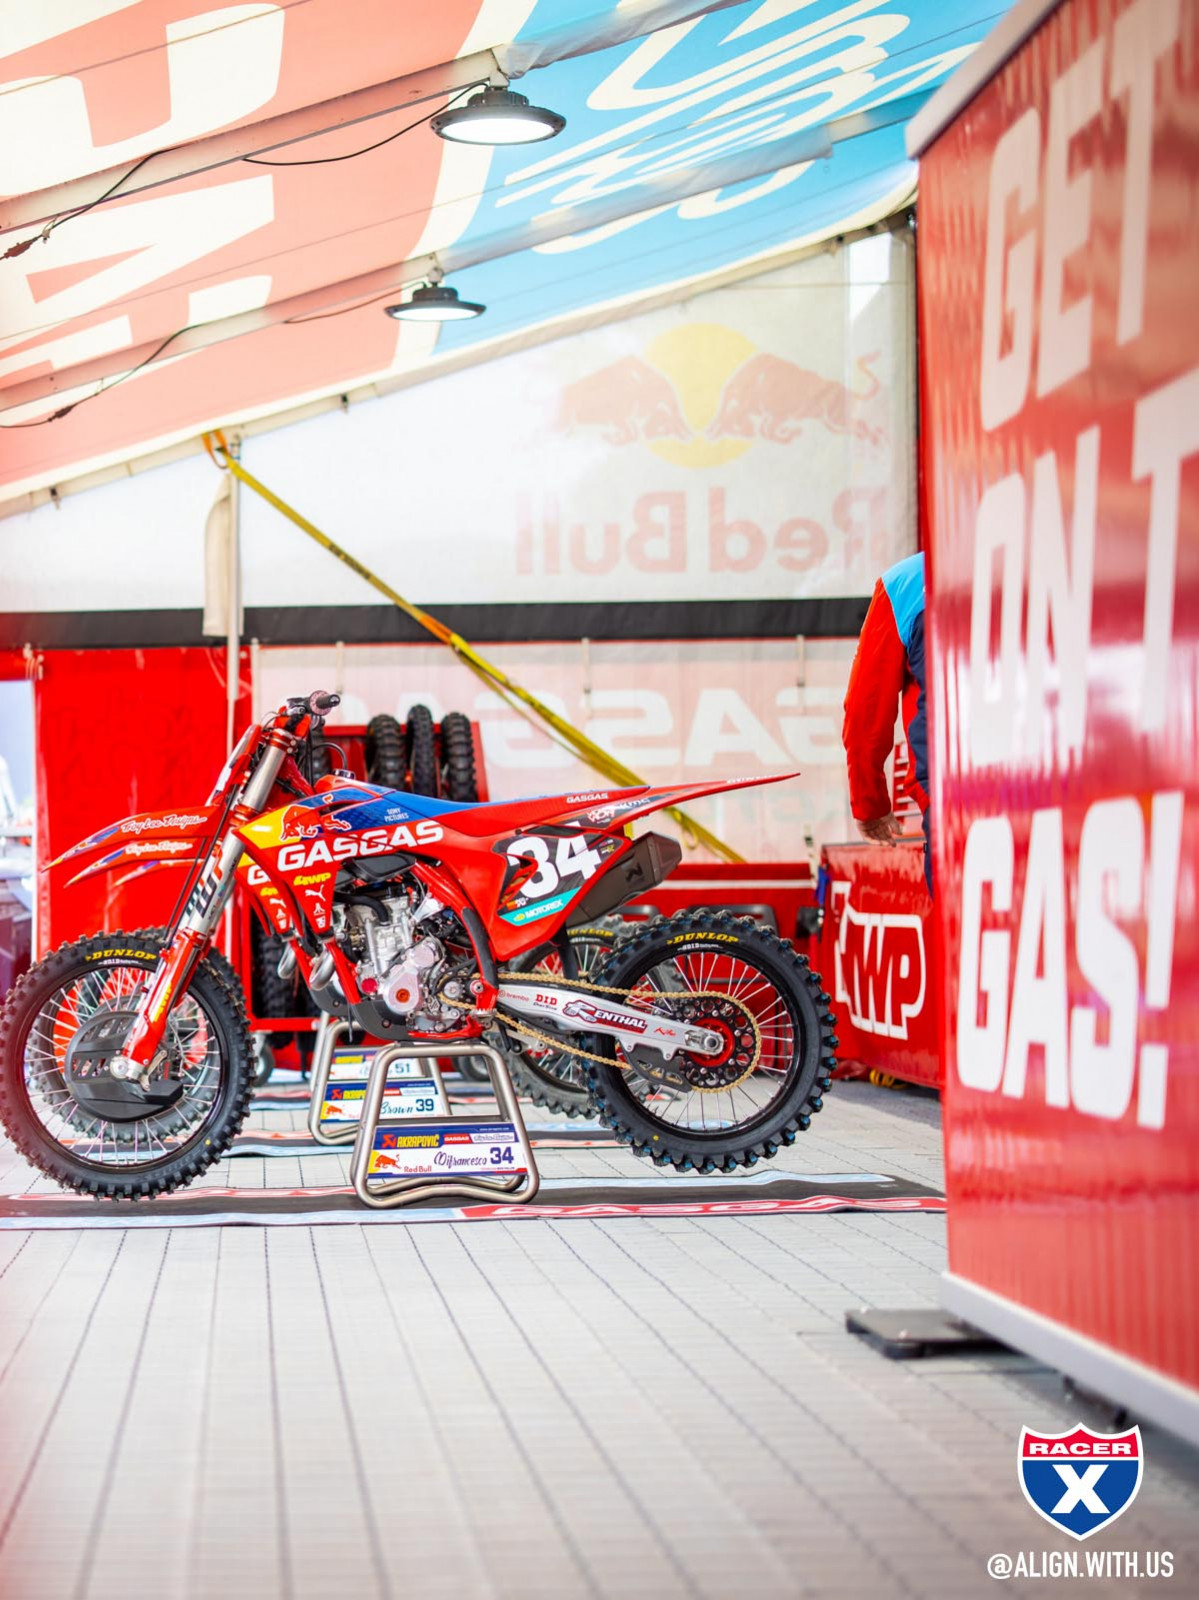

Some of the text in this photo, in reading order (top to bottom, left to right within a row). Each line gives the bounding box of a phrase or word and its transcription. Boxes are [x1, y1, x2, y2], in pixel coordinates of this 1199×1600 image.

[980, 0, 1181, 432] GET
[970, 425, 1100, 772] ON
[567, 793, 608, 804] GASGAS
[121, 814, 208, 835] Troy Lee Designs
[384, 813, 409, 822] PICTURES
[276, 821, 445, 873] GASGAS
[506, 821, 602, 899] 34
[525, 899, 563, 918] MOTOREX
[567, 928, 614, 938] UNLOP
[671, 931, 740, 945] DUNLOP
[90, 948, 157, 961] DUNLOP
[957, 792, 1184, 1131] GAS!
[394, 1063, 411, 1074] 51
[415, 1098, 435, 1112] 39
[489, 1146, 515, 1165] 34
[418, 1165, 432, 1173] Bull
